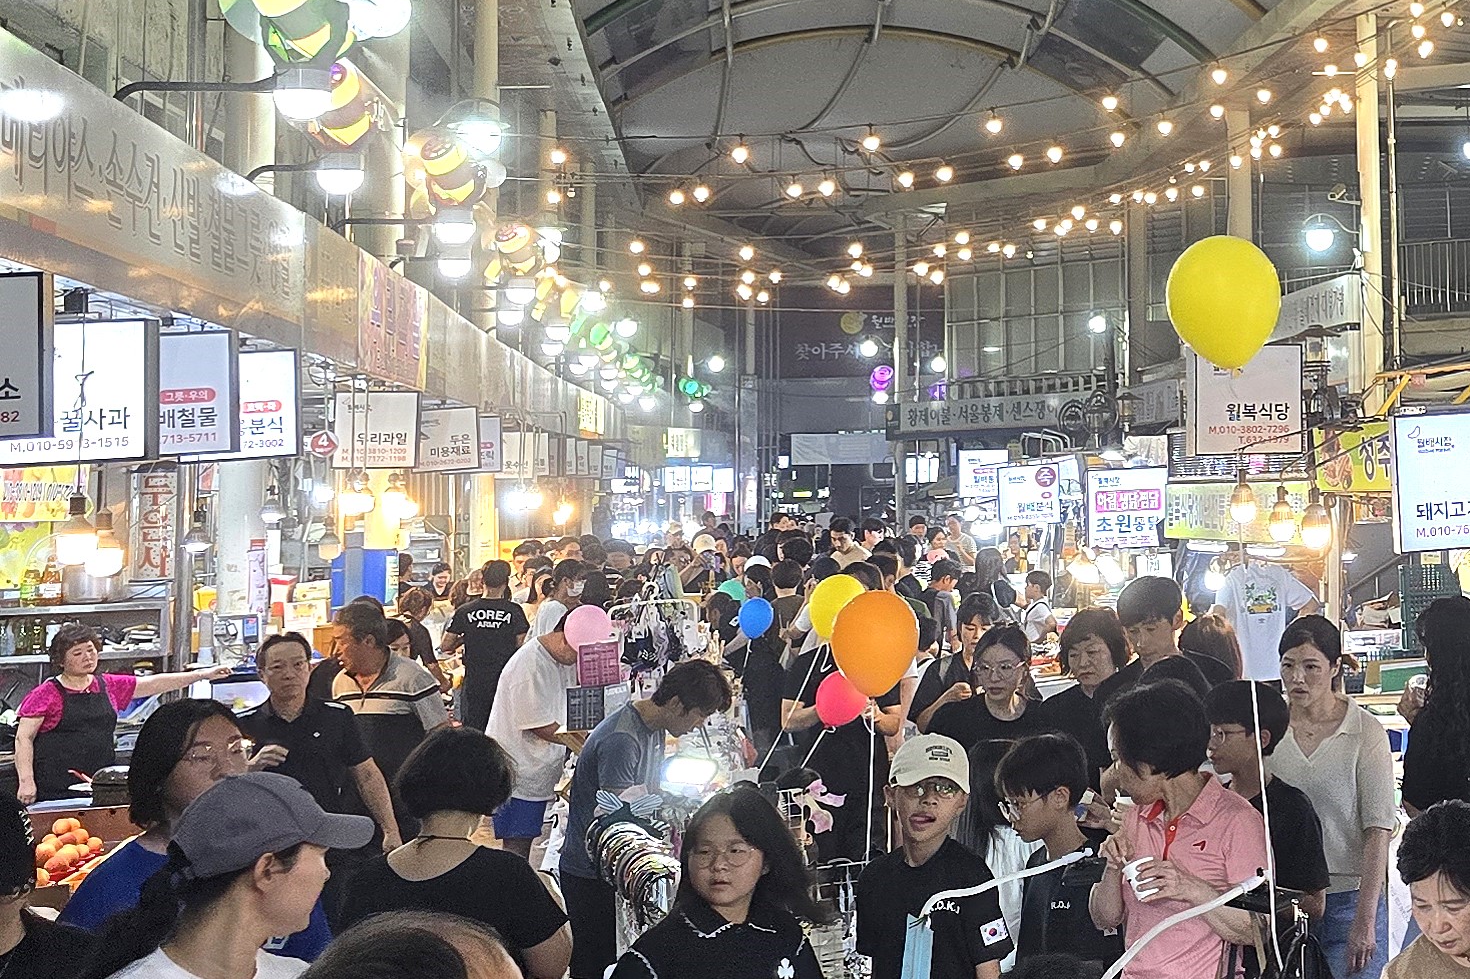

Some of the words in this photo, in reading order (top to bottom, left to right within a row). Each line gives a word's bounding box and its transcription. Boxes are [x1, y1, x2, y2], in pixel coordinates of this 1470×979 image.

[1225, 402, 1291, 422] 월복식당
[1208, 424, 1290, 435] M.010-3802-7296
[450, 434, 471, 445] 두은
[467, 608, 513, 625] KOREA
[476, 620, 503, 630] ARMY
